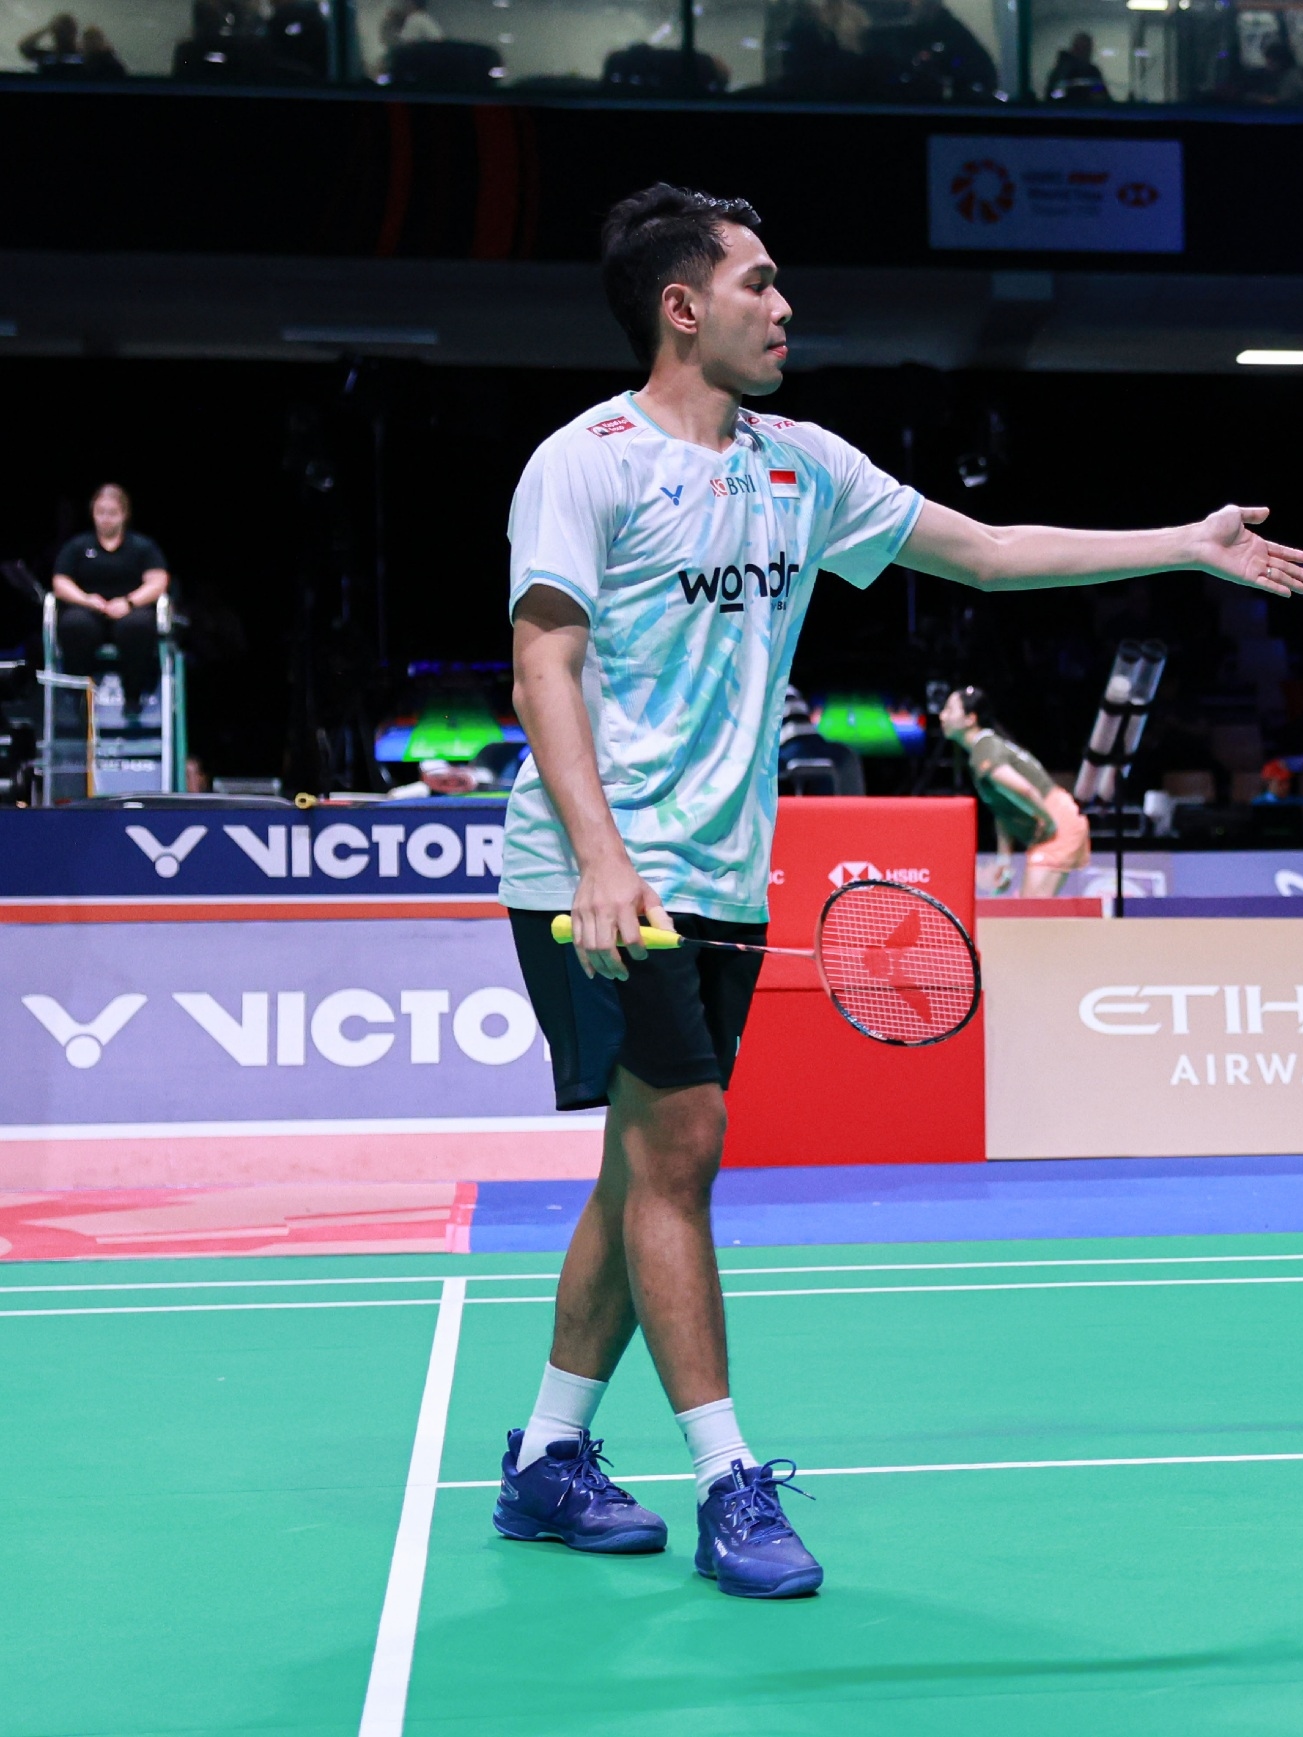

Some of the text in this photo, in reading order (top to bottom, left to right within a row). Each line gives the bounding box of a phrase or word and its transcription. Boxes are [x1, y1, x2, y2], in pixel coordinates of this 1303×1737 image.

[725, 475, 757, 496] BNI
[678, 551, 799, 605] wondr
[223, 823, 505, 879] VICTOR
[885, 868, 930, 884] HSBC
[172, 987, 551, 1067] VICTO
